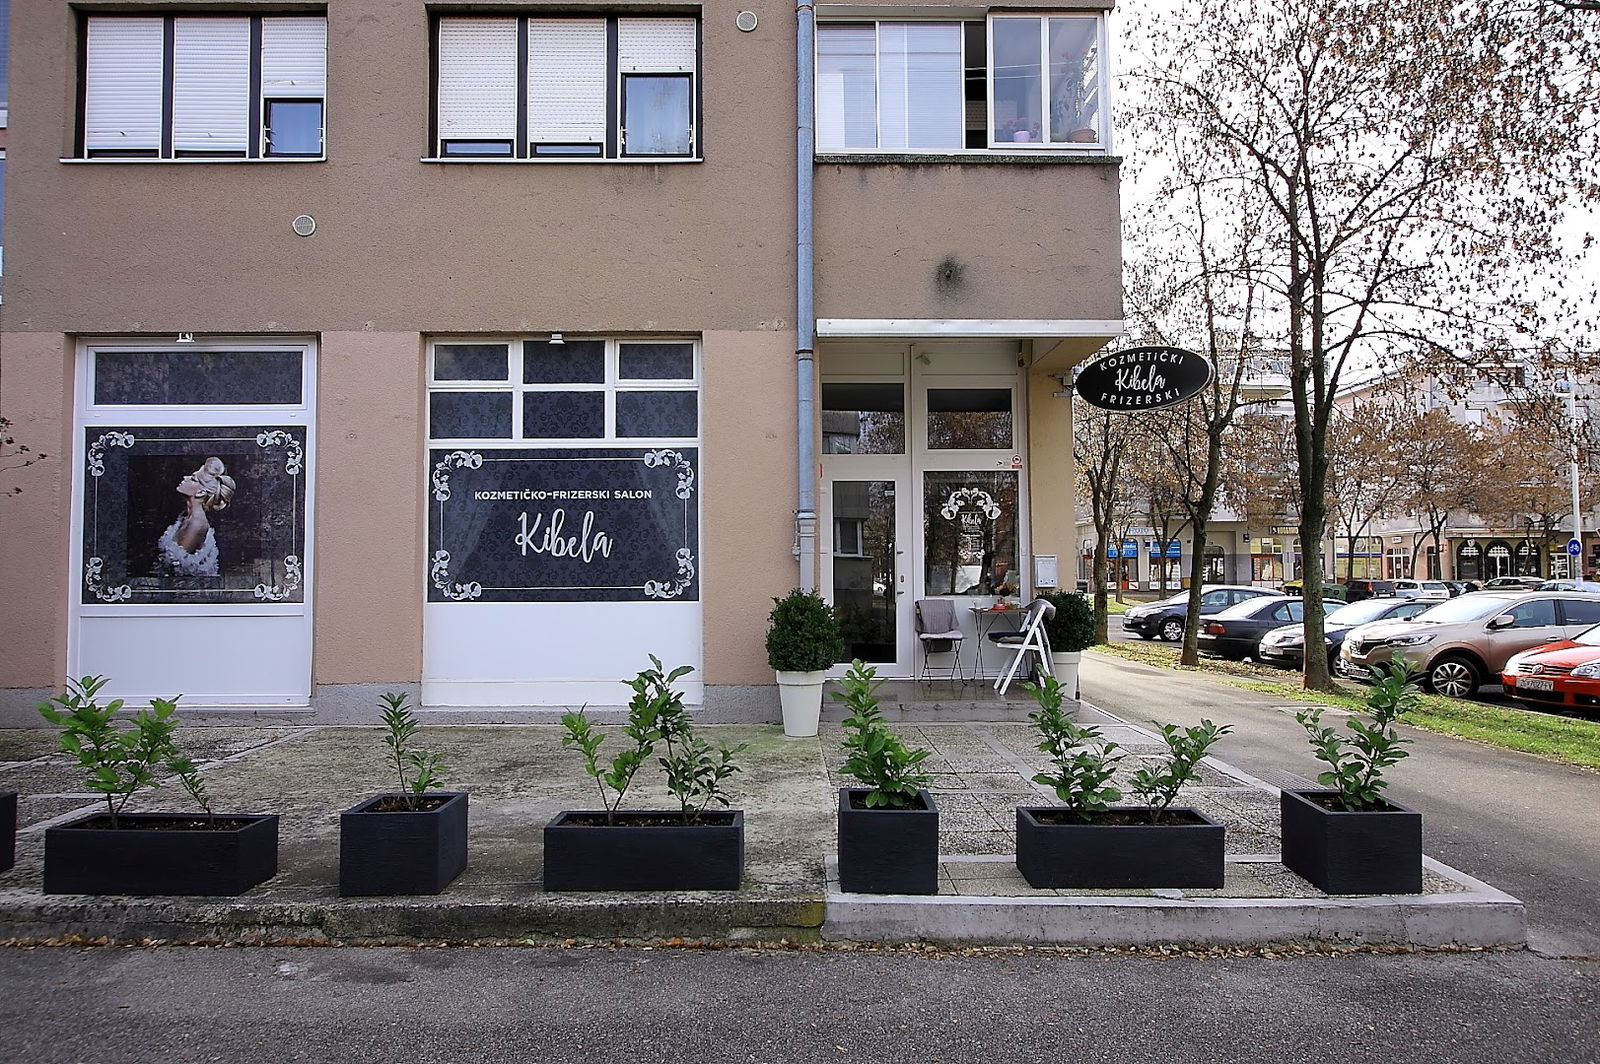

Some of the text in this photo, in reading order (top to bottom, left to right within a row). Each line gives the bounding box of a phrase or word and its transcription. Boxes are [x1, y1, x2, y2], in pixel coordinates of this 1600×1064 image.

[1100, 351, 1184, 371] KOZMETIČKI
[1115, 364, 1166, 393] Kibela
[1101, 388, 1180, 405] FRIZERSKI
[474, 489, 652, 500] KOZMETIČKO-FRIZERSKI SALON
[514, 508, 613, 563] Kibela
